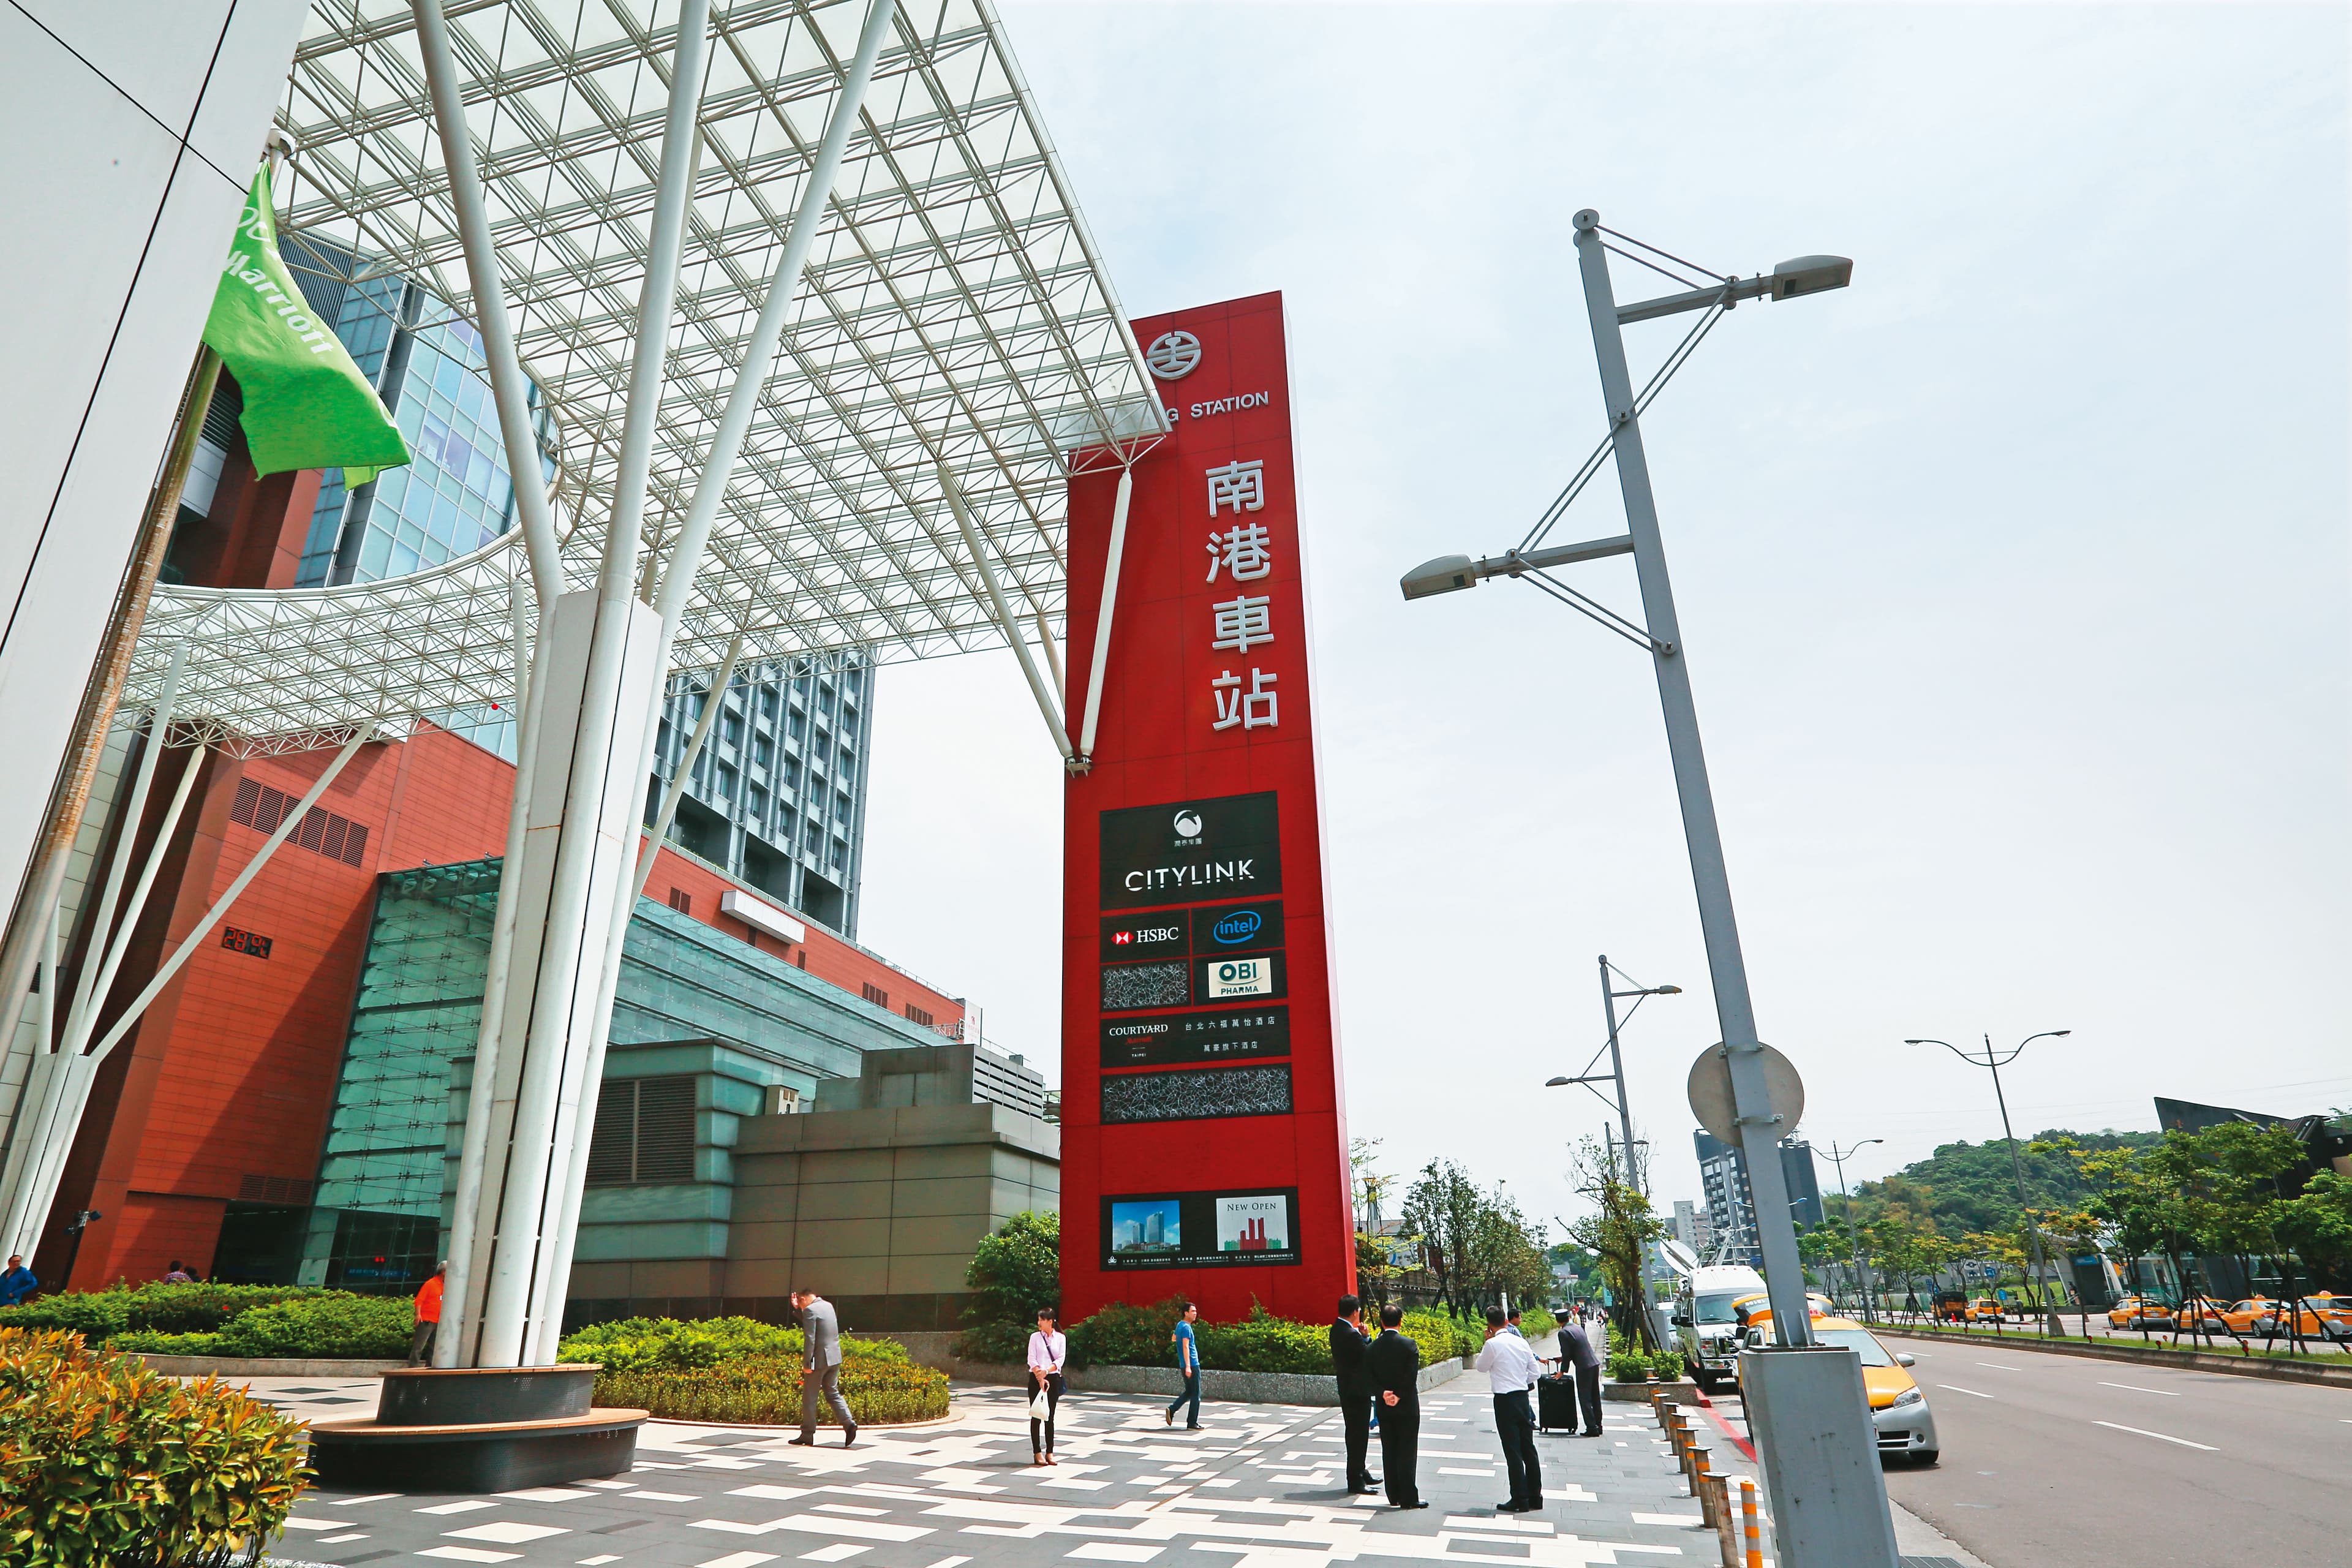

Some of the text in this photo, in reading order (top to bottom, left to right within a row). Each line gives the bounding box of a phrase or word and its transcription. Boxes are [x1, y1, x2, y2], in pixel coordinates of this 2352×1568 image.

[225, 250, 334, 355] Marriott
[1190, 391, 1269, 418] STATION
[1205, 460, 1279, 731] 南港車站
[1125, 859, 1256, 892] CITYLINK
[1136, 927, 1178, 943] HSBC
[1219, 916, 1253, 935] intel
[1219, 962, 1257, 981] OBI
[1221, 986, 1259, 995] PHARMA
[1109, 1024, 1168, 1036] COURTYARD
[1185, 1016, 1275, 1031] 台北六福萬怡酒店
[1227, 1202, 1276, 1212] NEW OPEN
